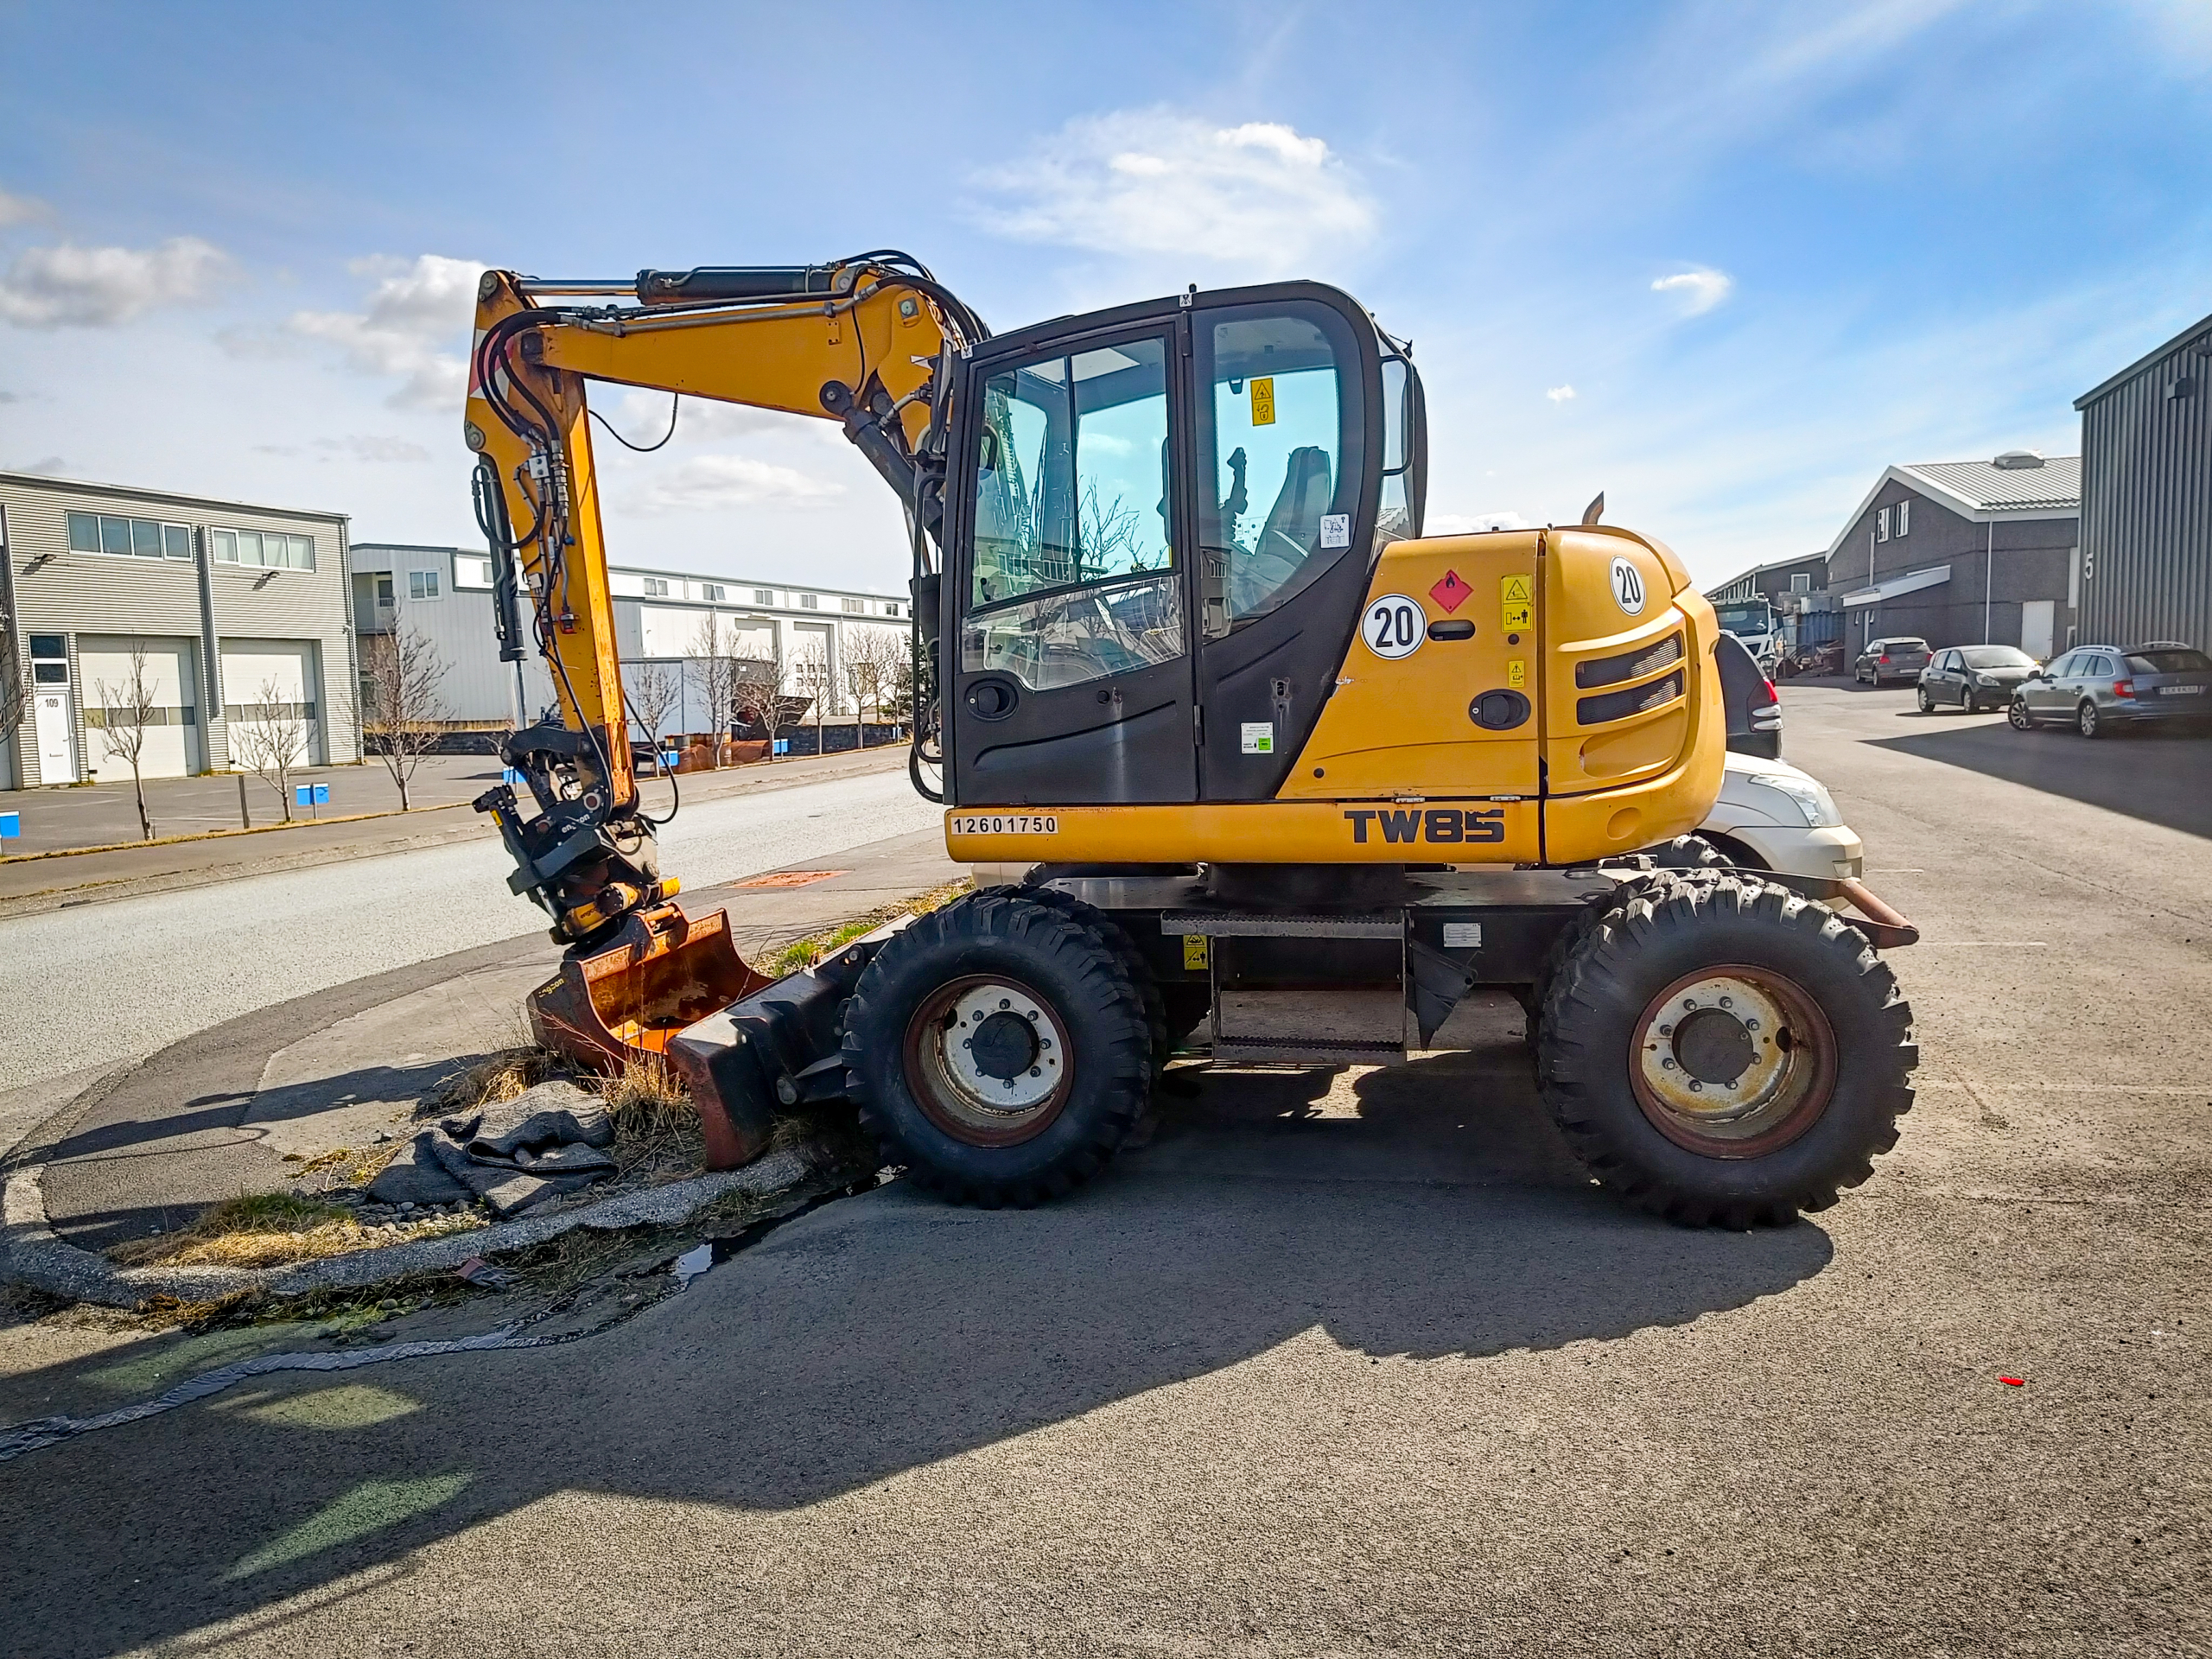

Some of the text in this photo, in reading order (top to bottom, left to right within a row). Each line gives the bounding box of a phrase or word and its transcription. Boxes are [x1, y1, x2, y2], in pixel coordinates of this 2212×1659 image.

[2085, 553, 2093, 580] 5
[1616, 565, 1641, 604] 20
[1375, 606, 1414, 648] 20
[45, 698, 59, 708] 109
[562, 814, 590, 833] enon
[954, 817, 1055, 833] 12601750
[1344, 810, 1504, 842] TW85
